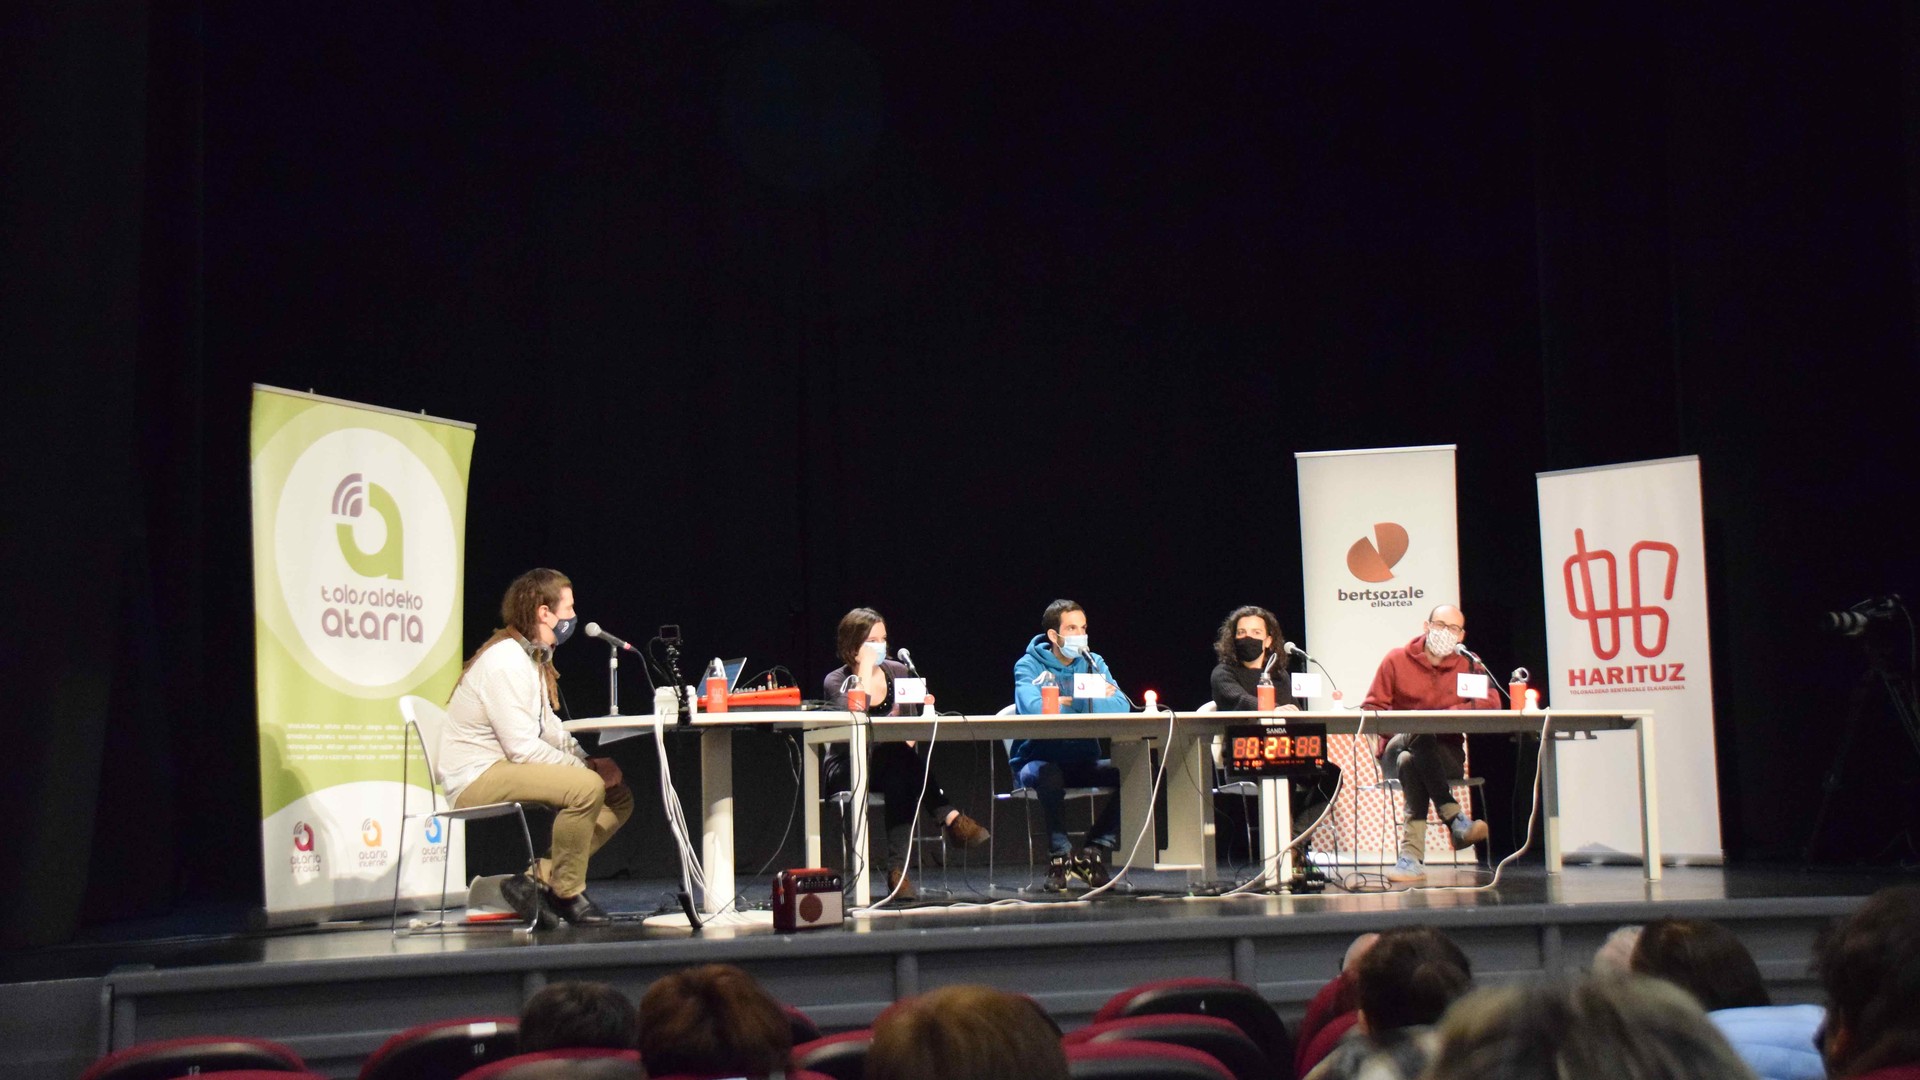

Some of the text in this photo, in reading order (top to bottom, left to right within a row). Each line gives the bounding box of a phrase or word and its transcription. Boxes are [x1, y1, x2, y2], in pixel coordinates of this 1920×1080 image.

[321, 584, 424, 611] tolosaldeko
[1337, 585, 1424, 601] bertsozale
[1370, 600, 1413, 608] elkartea
[321, 607, 424, 643] ataria
[1567, 662, 1686, 687] HARITUZ
[358, 850, 388, 860] ataria
[473, 1042, 486, 1054] 10
[188, 1065, 201, 1076] 12
